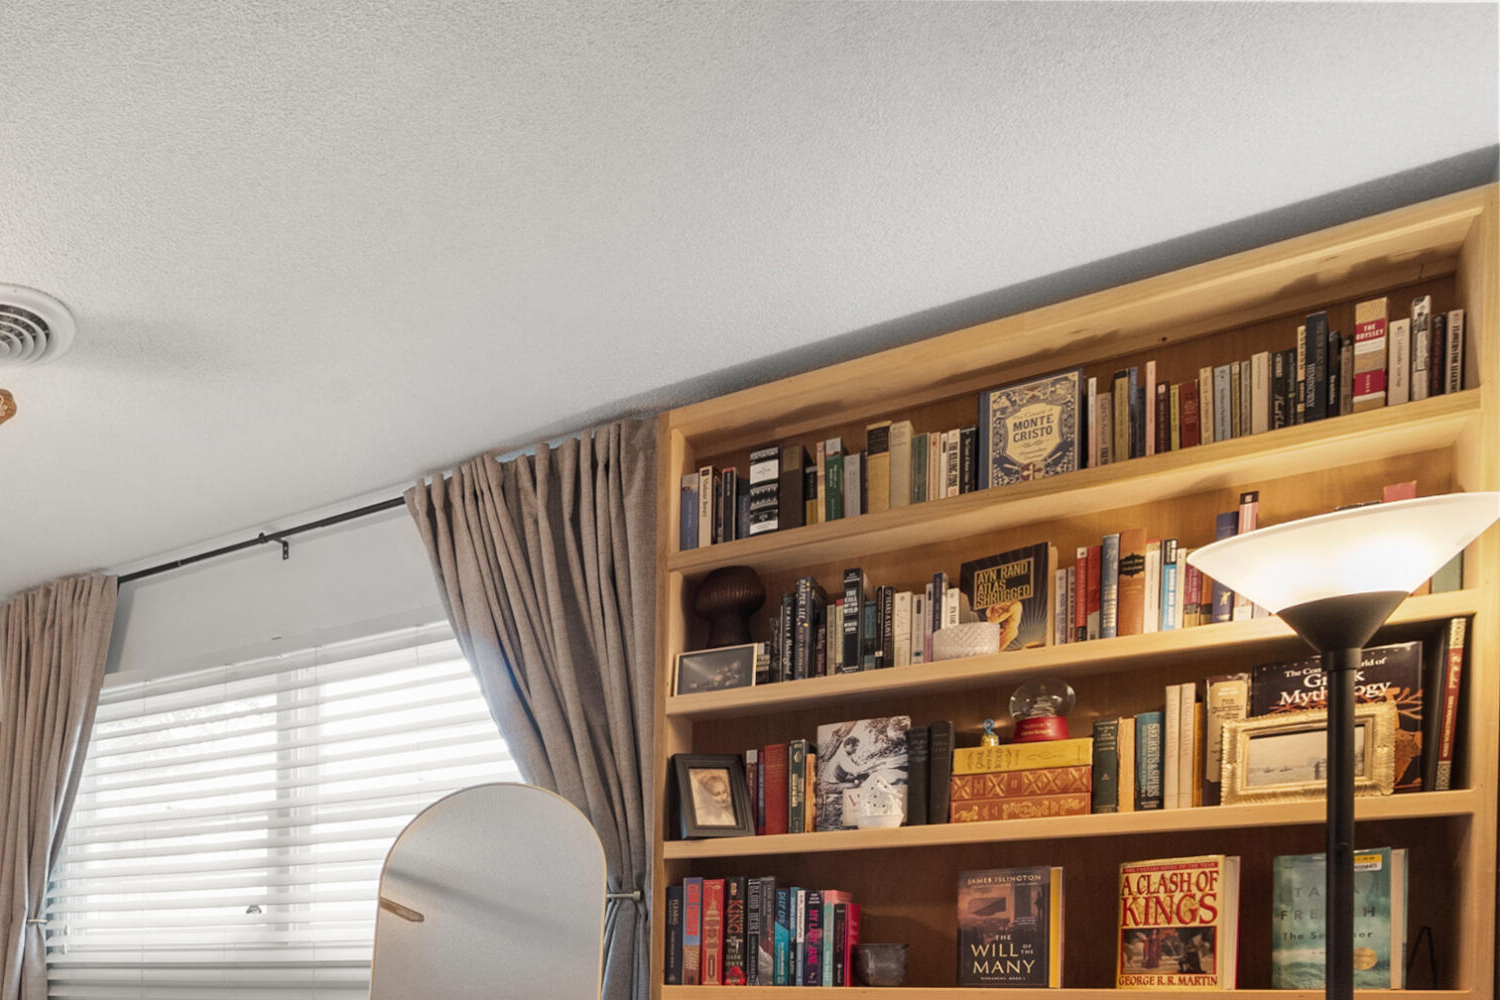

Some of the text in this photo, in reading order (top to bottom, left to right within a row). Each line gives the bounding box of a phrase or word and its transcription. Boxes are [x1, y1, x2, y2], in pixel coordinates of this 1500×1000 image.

[1356, 329, 1384, 340] ODYSSEY
[1364, 324, 1377, 332] THE
[1306, 363, 1315, 408] HEMINGWAY
[1012, 413, 1054, 432] MONTE
[1012, 426, 1053, 443] CRISTO
[978, 561, 1028, 584] AYN RAND
[976, 584, 1030, 607] SHRUGGED
[978, 579, 1006, 596] ATLAS
[1284, 670, 1300, 678] The
[967, 874, 1042, 885] JAMES ISLINGTON
[1121, 870, 1219, 896] A CLASH OF
[727, 900, 740, 934] KING
[748, 884, 760, 934] BLOOD HEIR
[1120, 892, 1218, 926] KINGS
[1280, 907, 1376, 920] FREH
[808, 910, 818, 966] MY LADY JANE
[1283, 932, 1304, 940] The
[970, 944, 1018, 958] WILL
[972, 960, 1035, 974] MANY
[1118, 976, 1218, 986] GEORGE R. R. MARTIN
